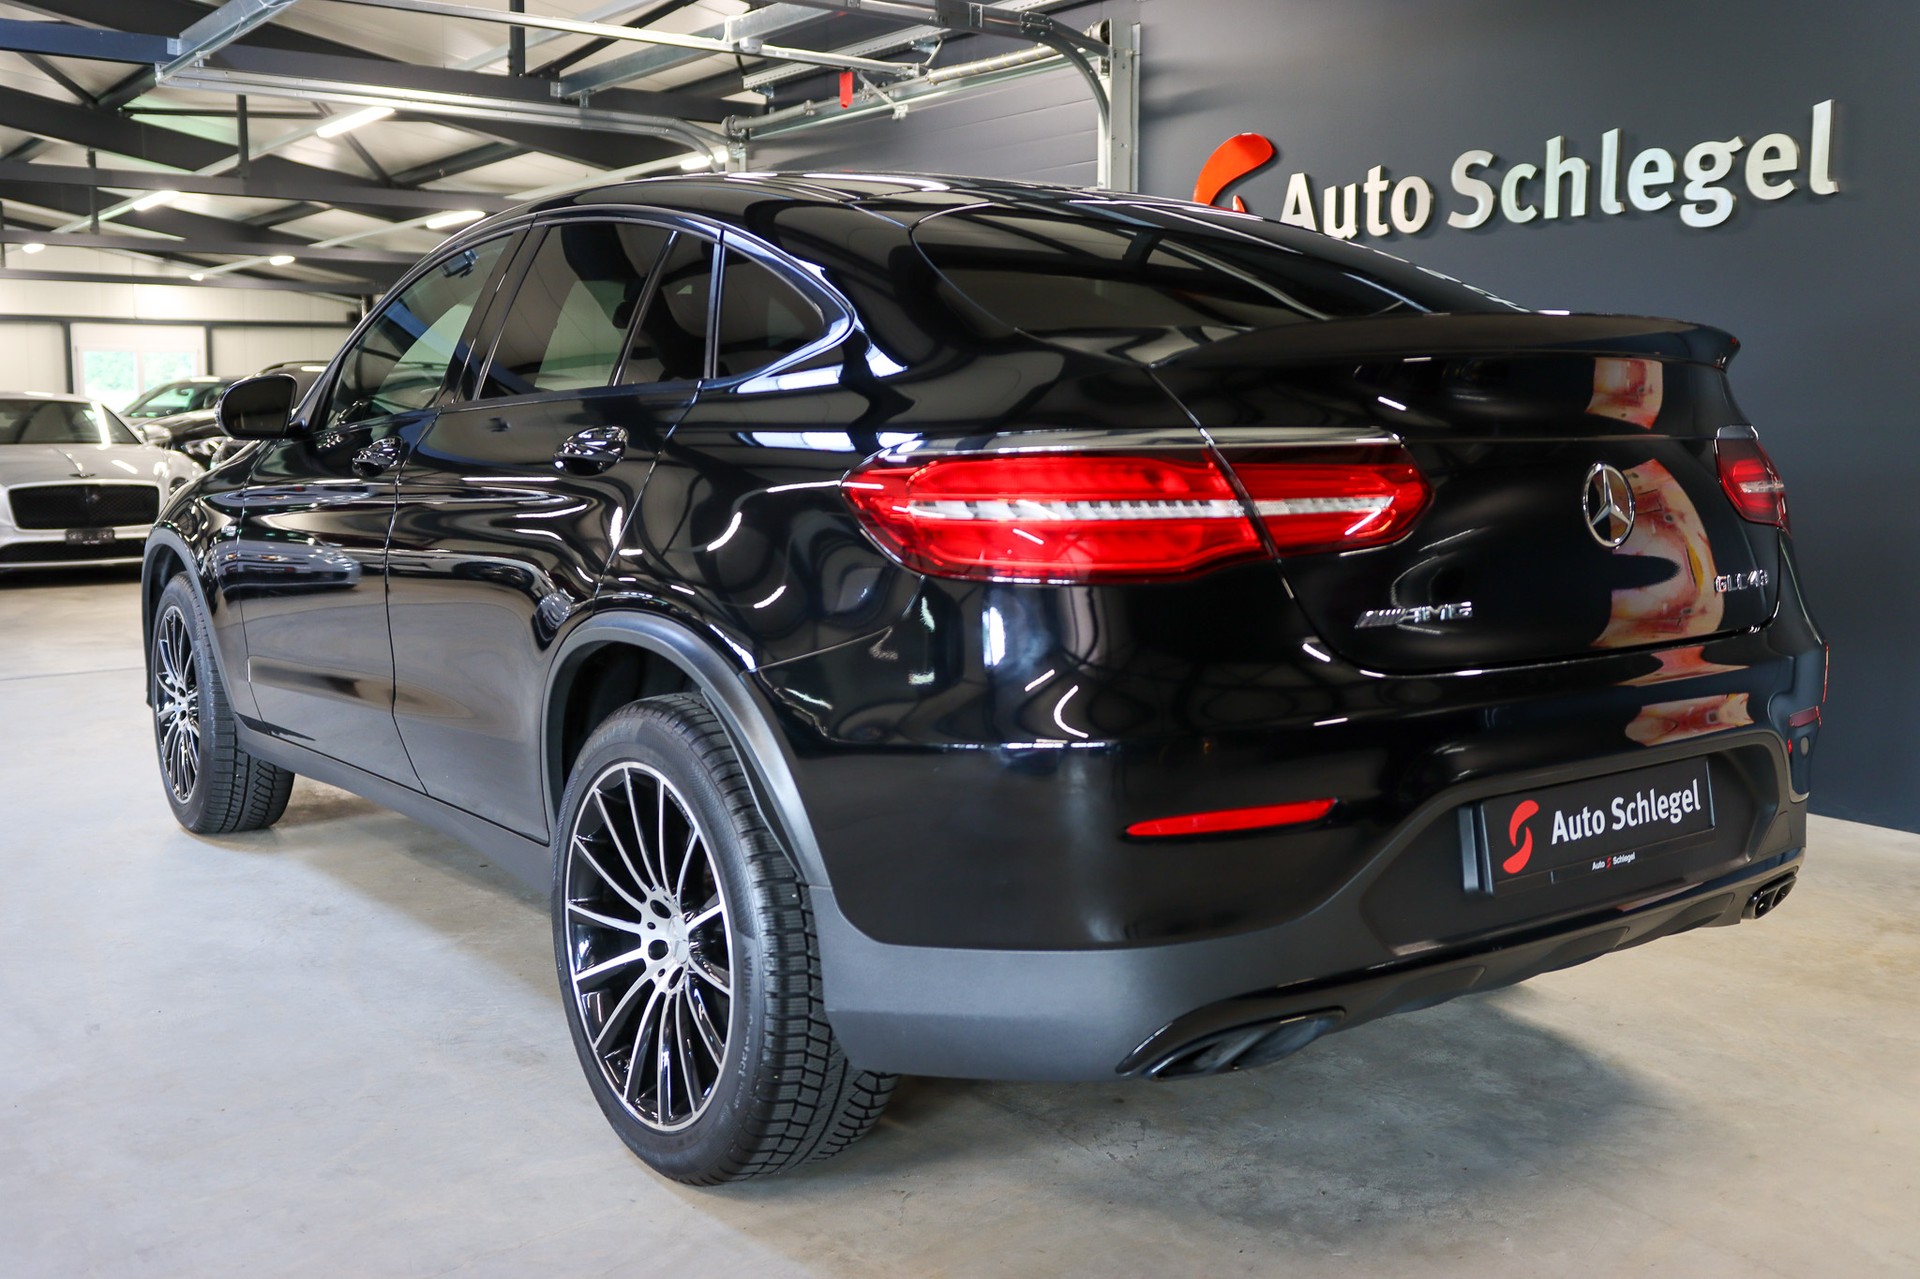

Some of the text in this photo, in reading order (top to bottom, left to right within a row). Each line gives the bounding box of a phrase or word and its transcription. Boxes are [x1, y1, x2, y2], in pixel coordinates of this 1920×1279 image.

[1280, 98, 1839, 239] Auto Schlegel
[1551, 778, 1701, 846] Auto Schlegel
[1591, 851, 1636, 871] Auto Schlegel
